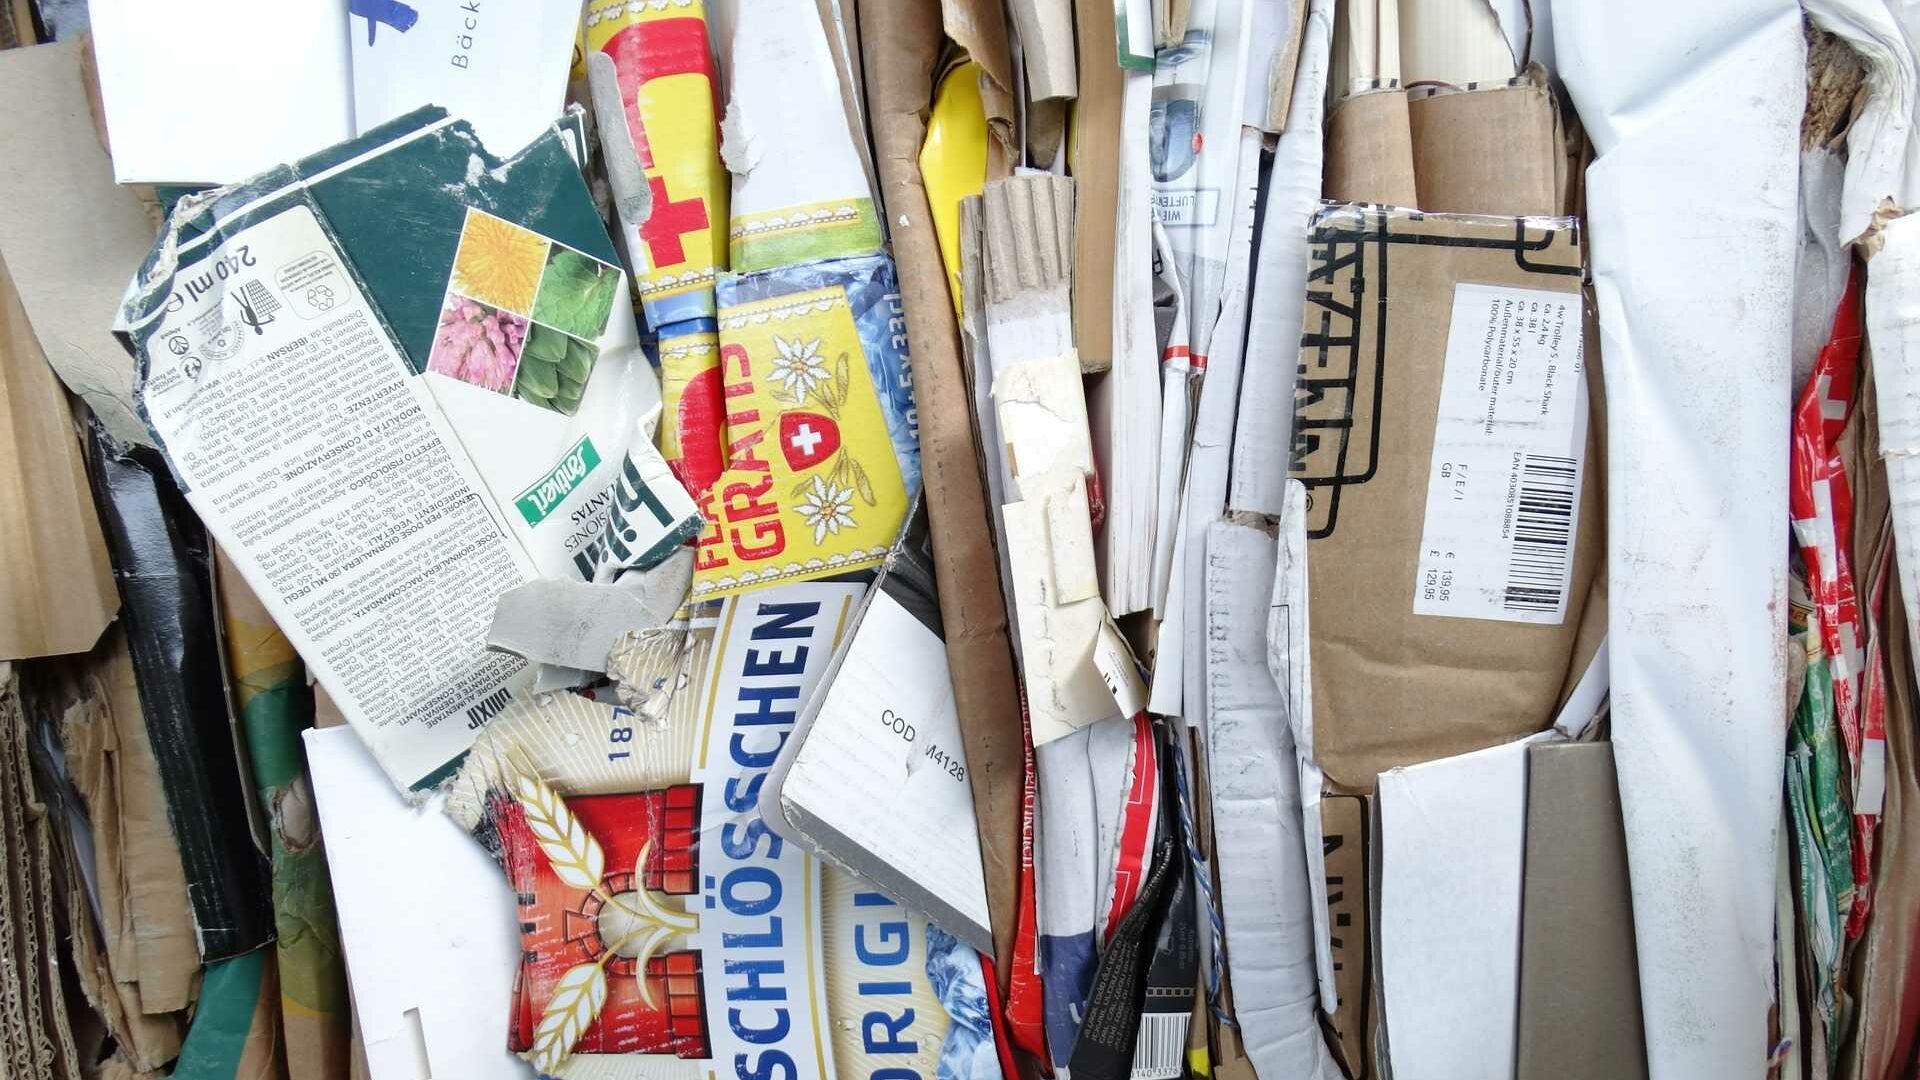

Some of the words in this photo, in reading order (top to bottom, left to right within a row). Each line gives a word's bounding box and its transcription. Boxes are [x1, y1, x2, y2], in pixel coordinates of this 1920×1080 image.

[215, 244, 257, 281] 240
[183, 277, 215, 303] ml
[1488, 299, 1501, 326] 100%
[1517, 300, 1526, 314] ca.
[1530, 302, 1538, 313] ca.
[1557, 305, 1566, 319] 4w
[1514, 315, 1524, 327] 38
[1528, 315, 1537, 330] 38
[1541, 319, 1550, 333] 2,4
[342, 333, 380, 358] Registro
[1512, 336, 1521, 349] 55
[1537, 333, 1547, 346] kg
[1550, 319, 1564, 352] Trolley
[265, 335, 309, 362] IBERSAN
[1478, 326, 1495, 392] Polycarbonate
[368, 351, 390, 368] dalla
[1508, 356, 1518, 369] 20
[285, 370, 309, 387] della
[336, 361, 369, 384] portata
[349, 371, 374, 387] come
[1505, 370, 1514, 385] cm
[1544, 364, 1557, 389] Black
[288, 385, 324, 409] bambini
[342, 377, 406, 416] AVVERTENZE:
[390, 393, 416, 412] luogo
[1540, 390, 1551, 416] Shark
[292, 405, 309, 417] una
[322, 410, 343, 426] Non
[245, 413, 270, 431] sotto
[282, 421, 324, 447] eccedere
[324, 427, 352, 447] riparo
[207, 442, 238, 463] Tenere
[221, 452, 240, 465] non
[247, 448, 272, 466] dose
[279, 434, 362, 483] CONSERVAZIONE:
[302, 442, 326, 459] dalla
[402, 436, 442, 462] EFFETTO
[192, 462, 221, 480] vanno
[1441, 462, 1453, 479] GB
[1512, 451, 1522, 471] EAN
[198, 458, 249, 491] giornaliera
[253, 464, 281, 485] Dopo
[345, 456, 404, 493] FISIOLOGICO:
[227, 479, 279, 511] Conservare
[318, 485, 347, 507] Agisce
[440, 491, 475, 515] TENORE
[423, 510, 442, 525] PER
[364, 516, 412, 548] VEGETALI:
[398, 520, 424, 539] DOSE
[473, 529, 498, 548] DOSE
[340, 534, 400, 572] GIORNALIERA
[421, 543, 475, 578] GIORNALIERA
[308, 573, 328, 589] ML)
[325, 565, 342, 580] (30
[281, 584, 311, 605] DEGLI
[1424, 568, 1438, 600] 129,95
[1439, 570, 1453, 602] 139,95
[350, 573, 423, 619] RACCOMANDATA:
[461, 673, 490, 695] PIANTE
[424, 692, 476, 729] ALIMENTARE
[881, 709, 916, 742] COD
[704, 601, 822, 1080] SCHLÖSSCHEN
